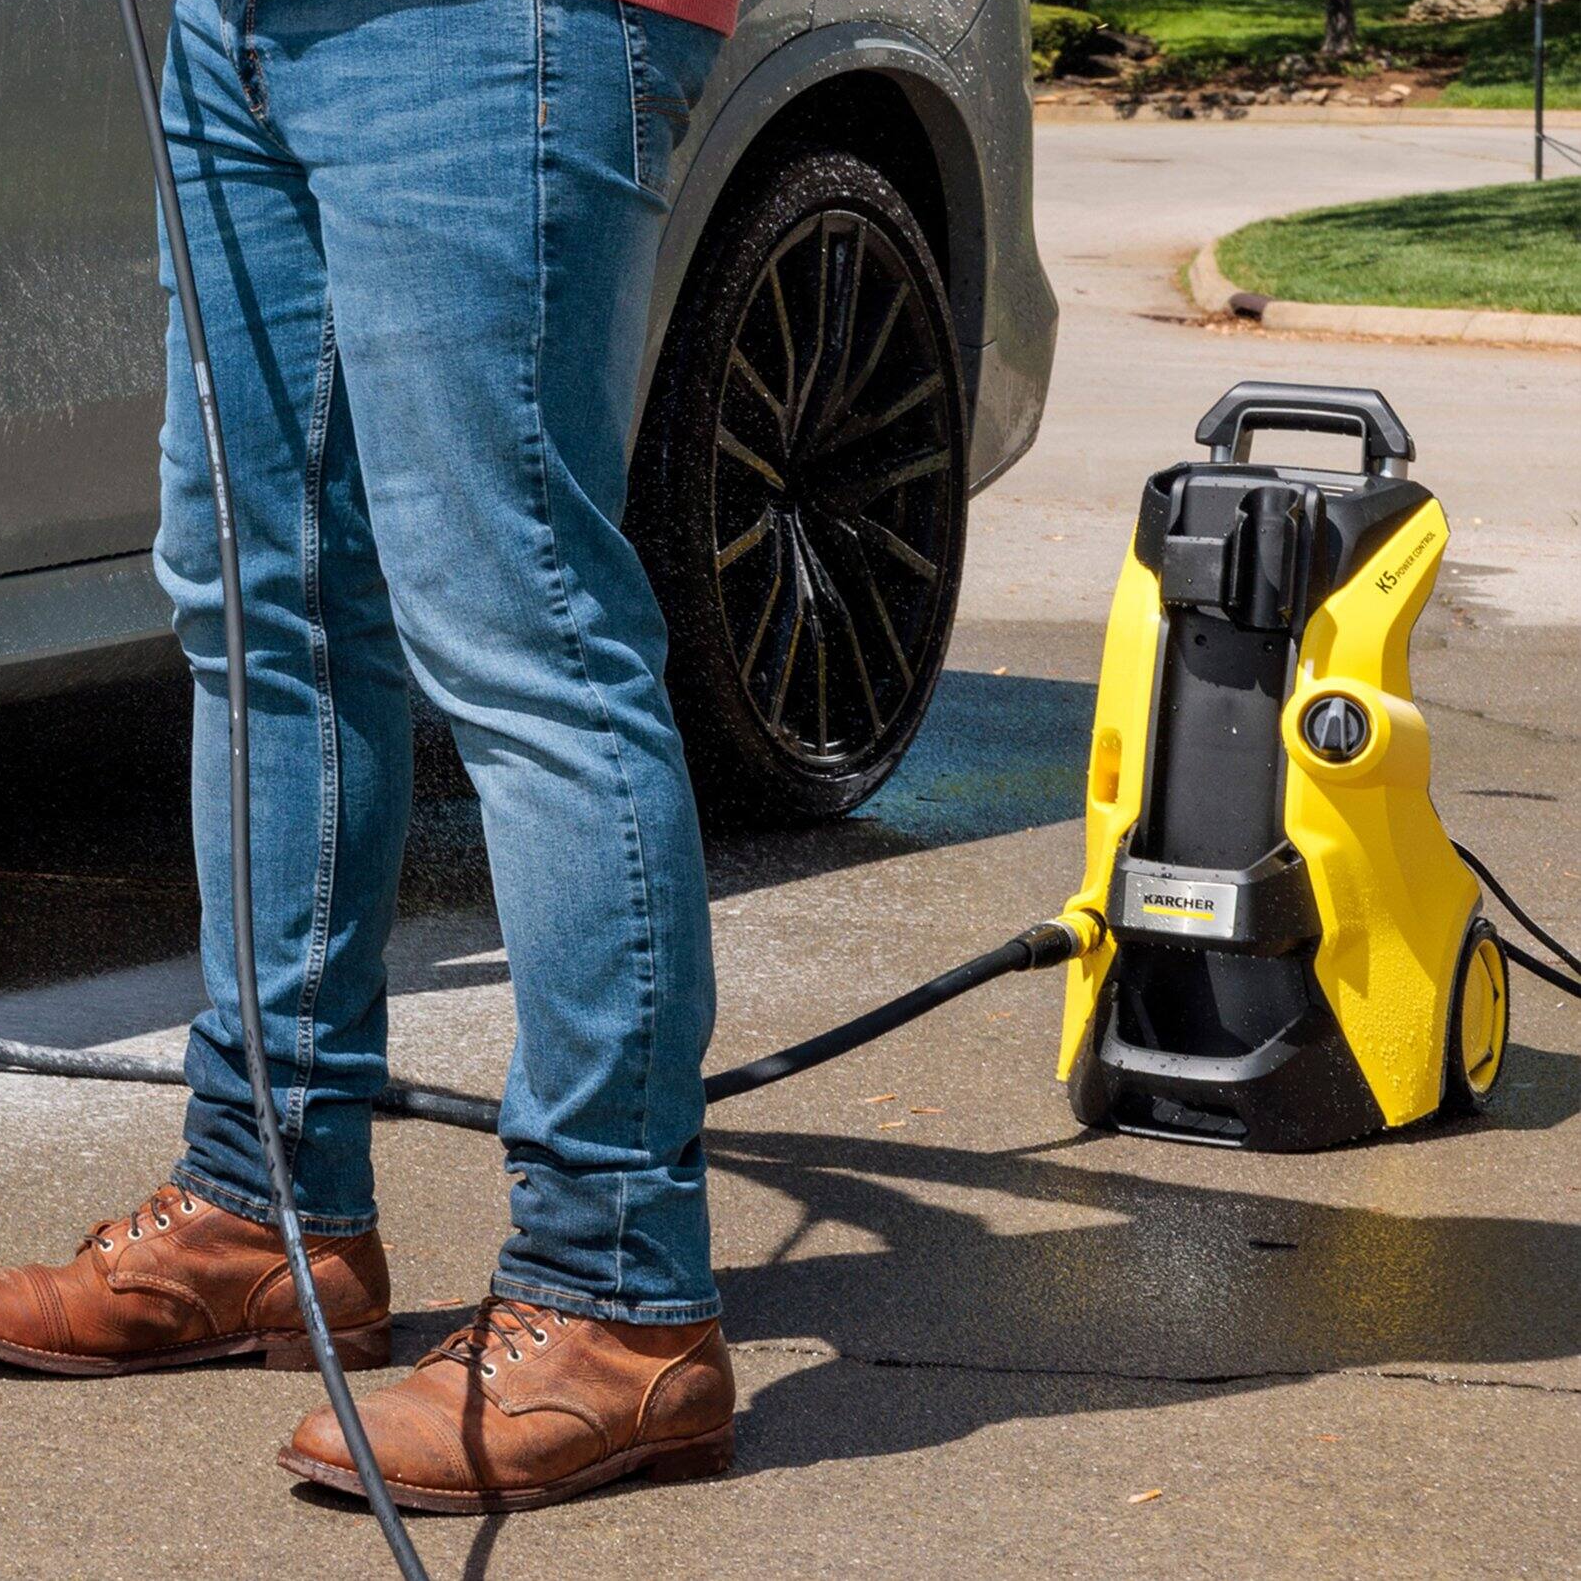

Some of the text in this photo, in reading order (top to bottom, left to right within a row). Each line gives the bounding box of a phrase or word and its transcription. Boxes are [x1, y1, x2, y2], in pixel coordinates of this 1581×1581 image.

[1375, 531, 1436, 594] K5 POWER CONTROL
